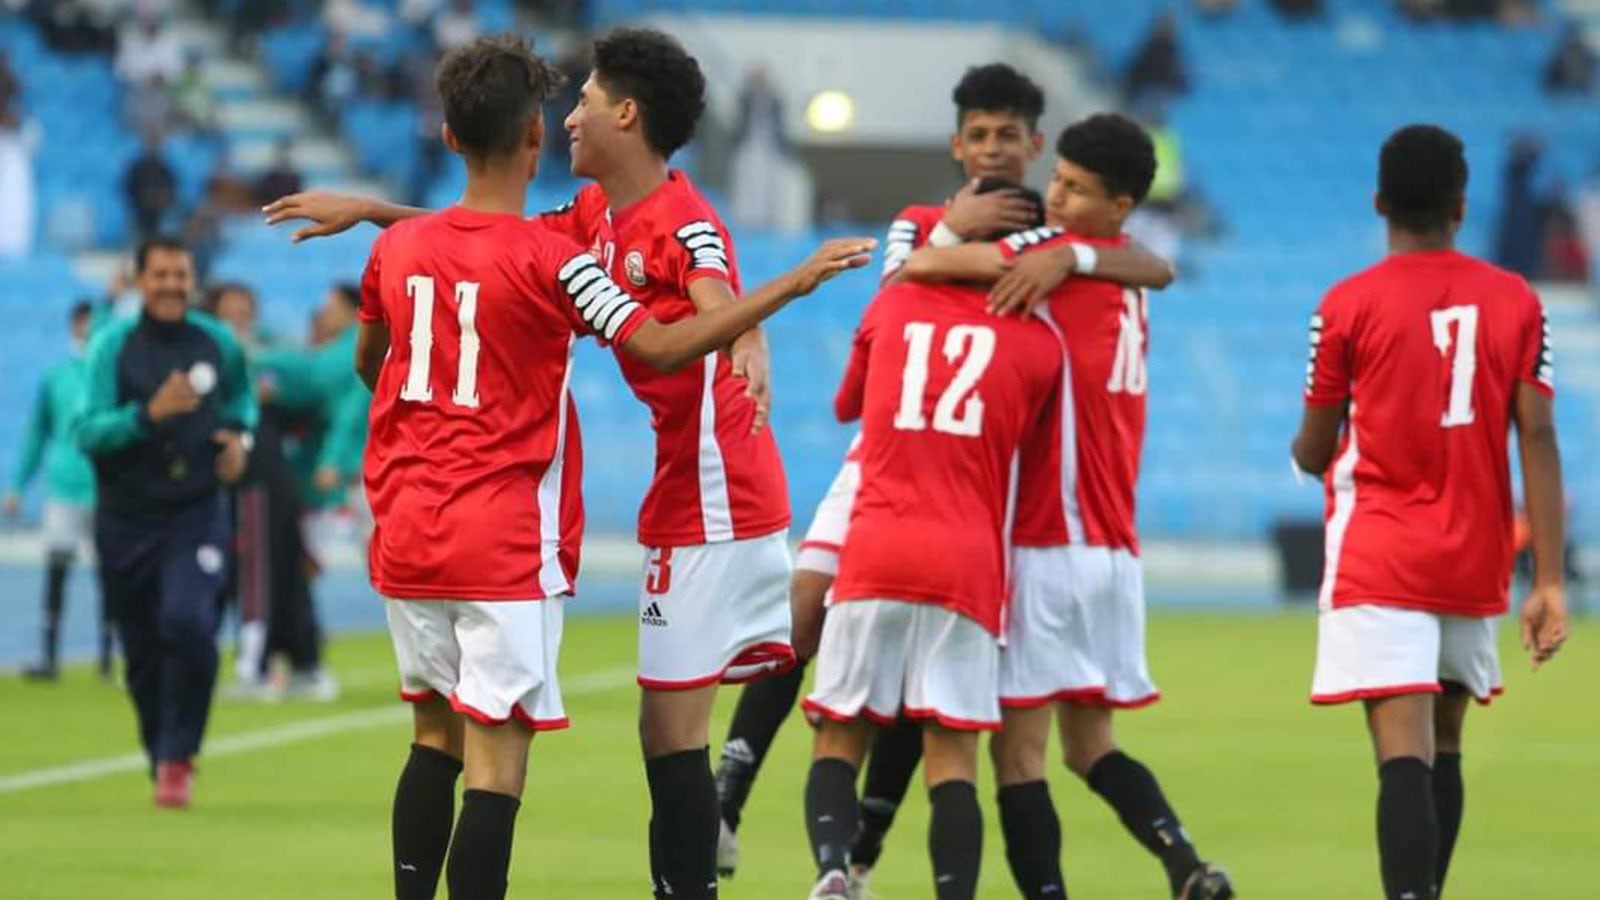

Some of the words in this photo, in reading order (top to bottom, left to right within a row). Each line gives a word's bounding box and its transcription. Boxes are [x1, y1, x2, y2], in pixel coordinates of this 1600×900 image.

[400, 275, 481, 409] 11
[893, 321, 996, 438] 12
[1429, 304, 1479, 428] 7
[646, 546, 673, 595] 3
